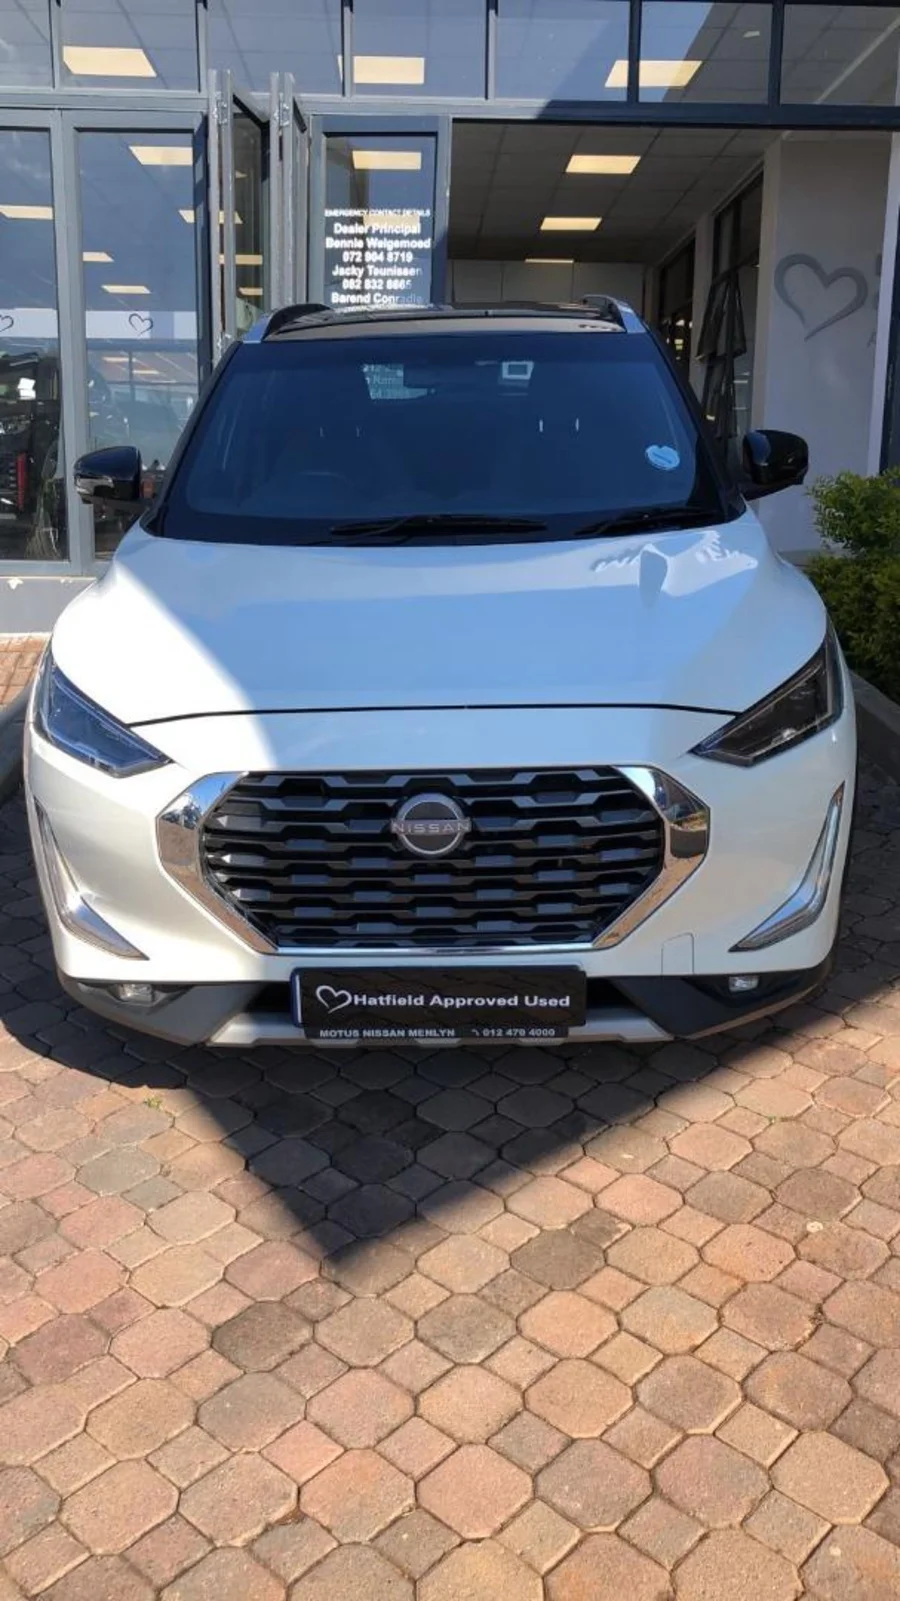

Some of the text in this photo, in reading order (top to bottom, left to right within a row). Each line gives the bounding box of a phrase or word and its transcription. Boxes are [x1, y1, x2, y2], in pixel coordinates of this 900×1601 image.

[333, 223, 422, 237] Dealer Principal
[342, 251, 362, 262] 072
[332, 264, 365, 278] Jacky
[331, 292, 371, 304] Barend
[391, 822, 470, 834] NISSAN
[353, 994, 570, 1009] Hatfield Approved Used
[319, 1029, 359, 1038] MOTUS
[362, 1029, 405, 1038] NISSAN
[408, 1028, 455, 1037] MENLYN
[482, 1027, 503, 1037] 012
[528, 1027, 556, 1037] 4000
